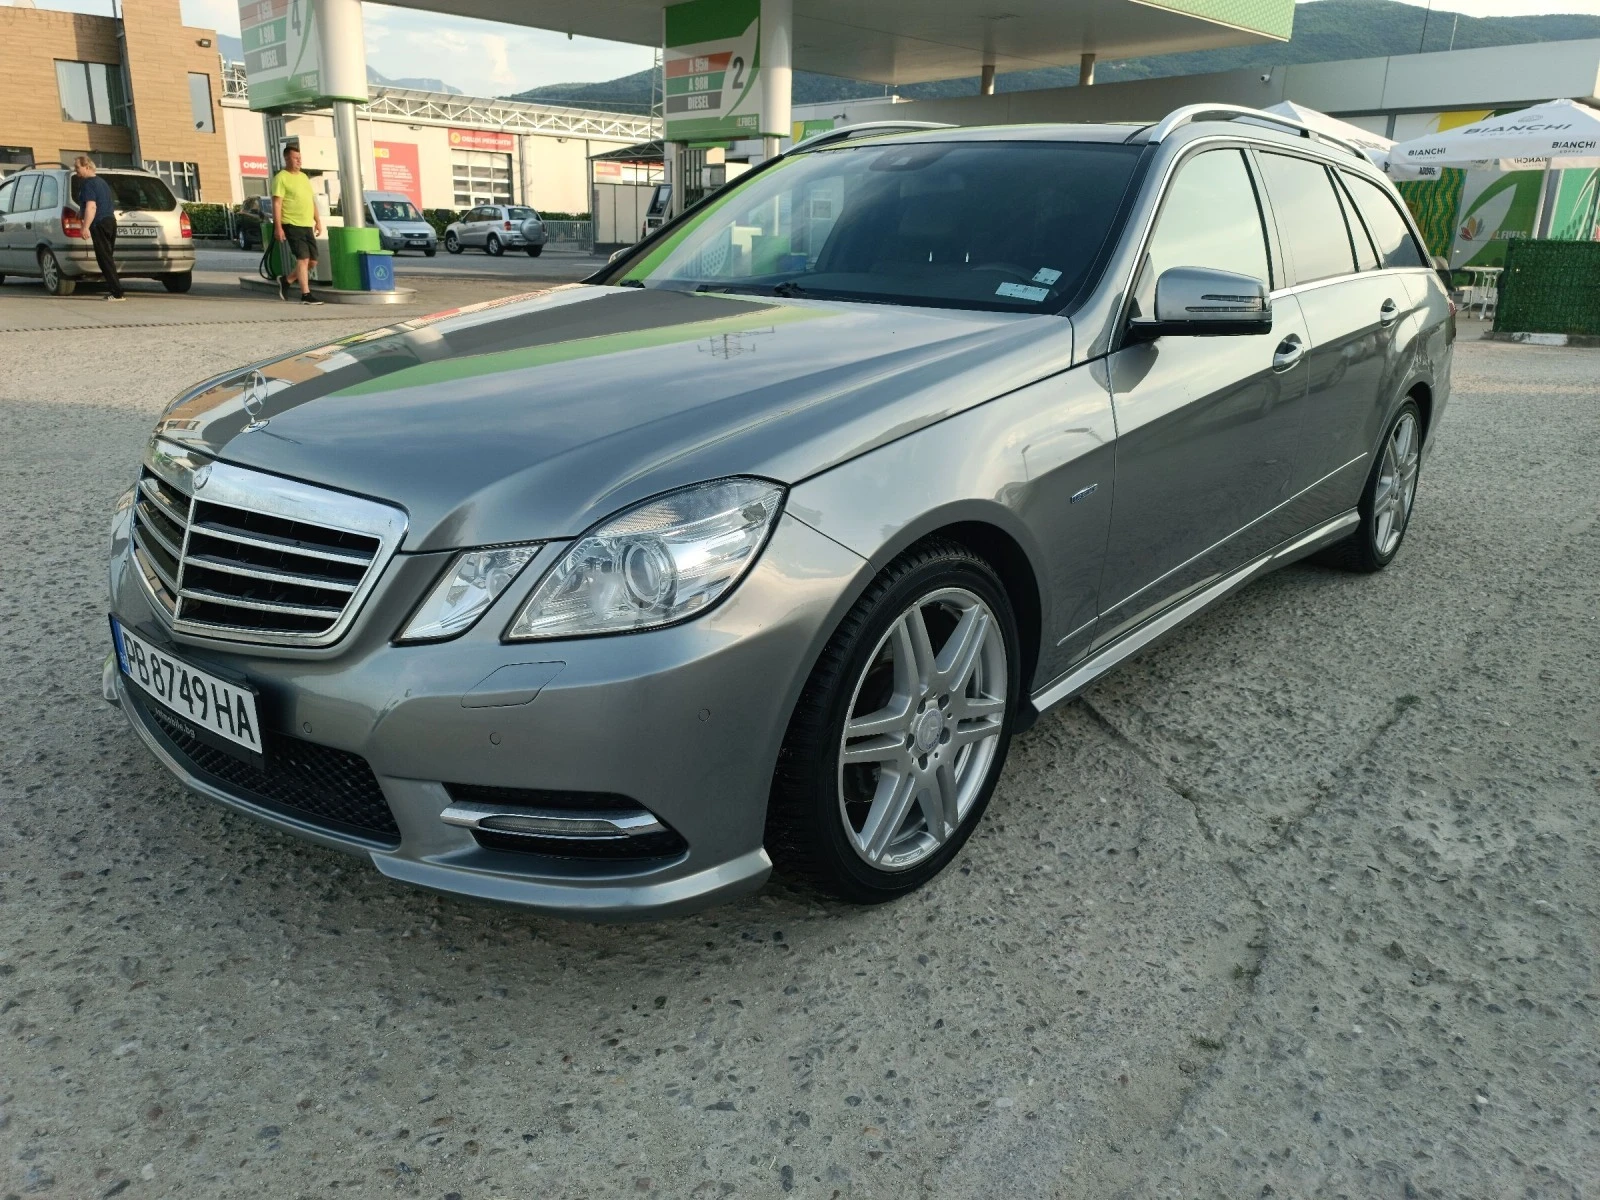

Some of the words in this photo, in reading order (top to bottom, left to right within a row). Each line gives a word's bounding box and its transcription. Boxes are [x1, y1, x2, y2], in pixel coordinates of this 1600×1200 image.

[292, 0, 301, 36] 4
[261, 50, 278, 69] DIESEL
[688, 59, 694, 73] A
[732, 56, 744, 89] 2
[688, 79, 694, 91] A
[688, 95, 709, 110] DIESEL
[1463, 123, 1573, 135] BIANCHI
[1408, 147, 1446, 156] BIANCHI
[1551, 141, 1597, 149] BIANCHI
[243, 161, 268, 170] ОФИС
[123, 632, 150, 686] PB
[151, 653, 208, 721] 8749
[211, 683, 256, 744] HA
